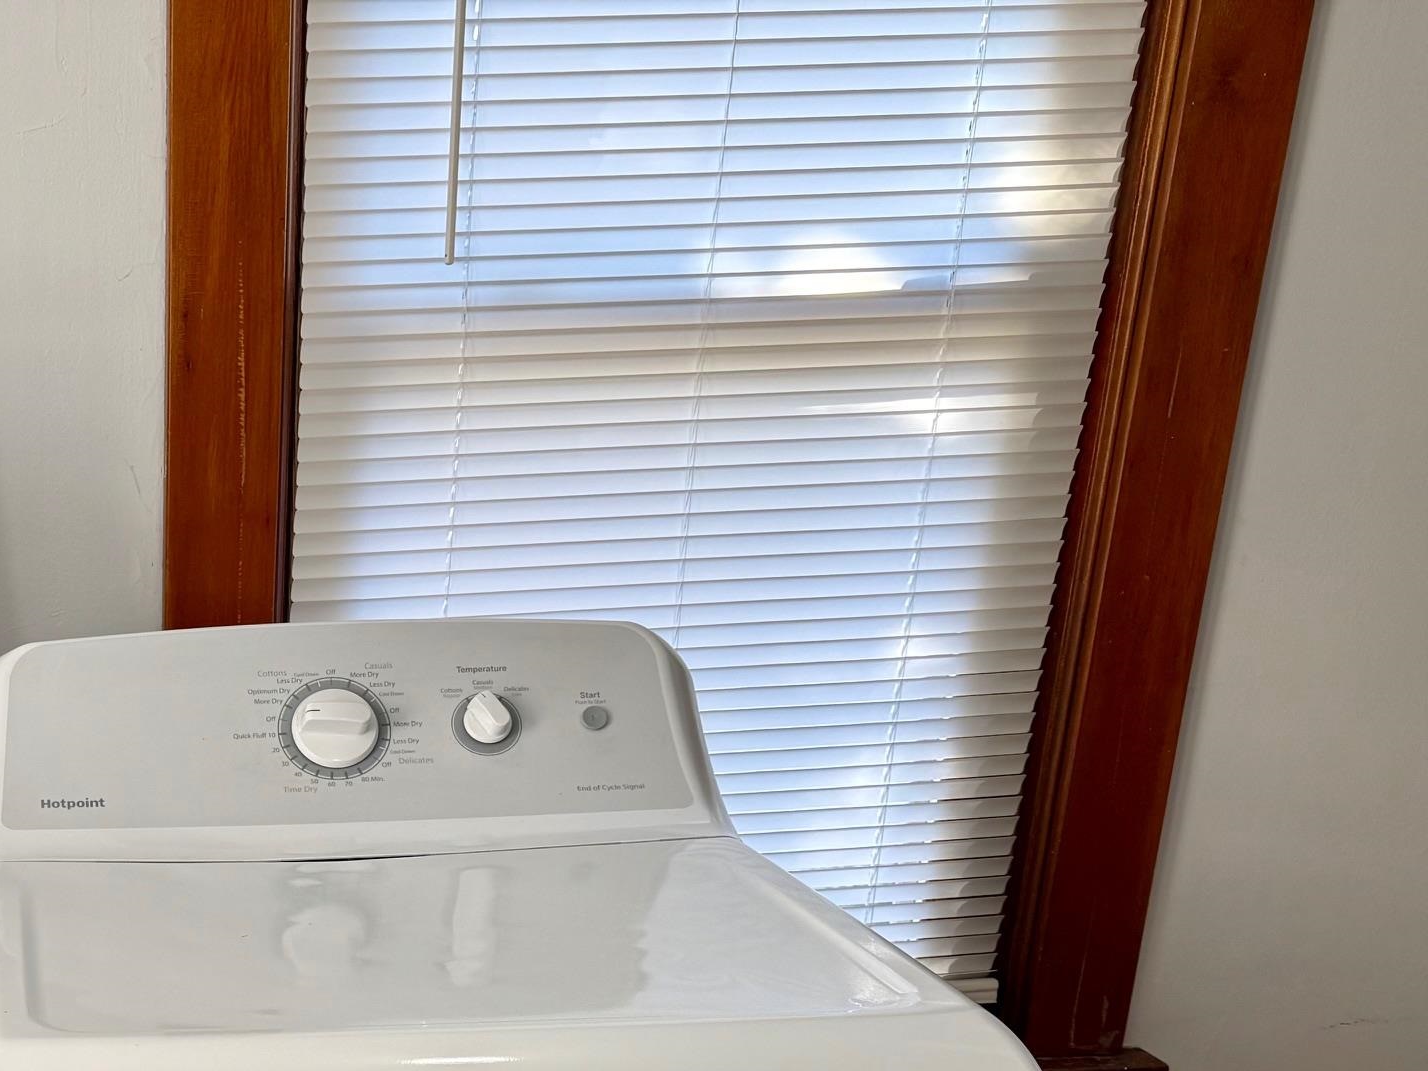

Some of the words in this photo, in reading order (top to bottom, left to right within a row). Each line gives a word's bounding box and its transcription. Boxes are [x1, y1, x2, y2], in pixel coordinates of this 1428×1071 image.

[364, 662, 393, 670] Casuals
[456, 665, 507, 674] Temperature
[580, 691, 601, 699] Start
[398, 757, 433, 765] Delicates
[601, 784, 622, 792] Cycle
[40, 797, 106, 810] Hotpoint
